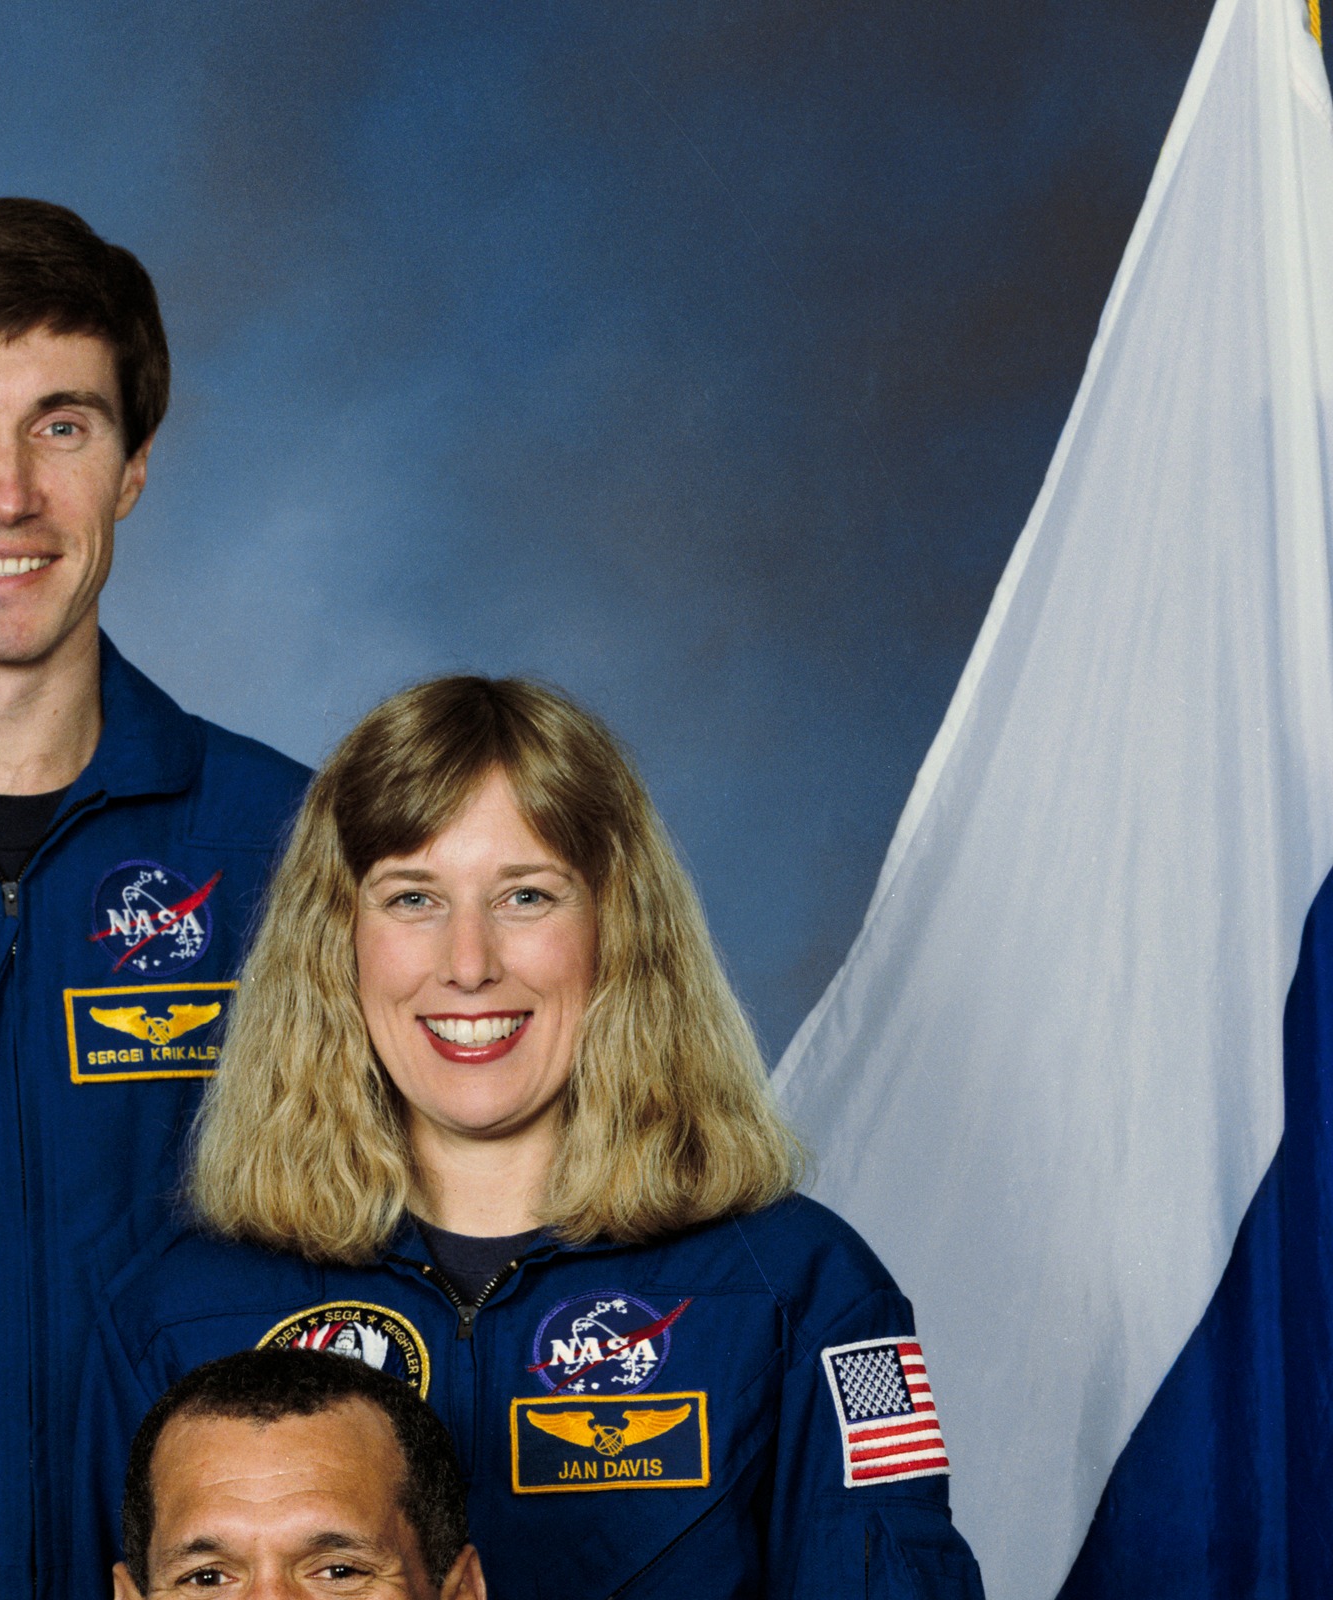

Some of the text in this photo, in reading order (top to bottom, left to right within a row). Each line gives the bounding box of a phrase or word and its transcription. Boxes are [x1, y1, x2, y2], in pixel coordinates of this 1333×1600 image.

[107, 909, 205, 937] NASA
[87, 1049, 144, 1065] SERGEI
[324, 1310, 361, 1322] SEGA
[382, 1319, 419, 1375] REIGHTLER
[549, 1336, 659, 1366] NASA
[558, 1458, 663, 1479] JAN DAVIS
